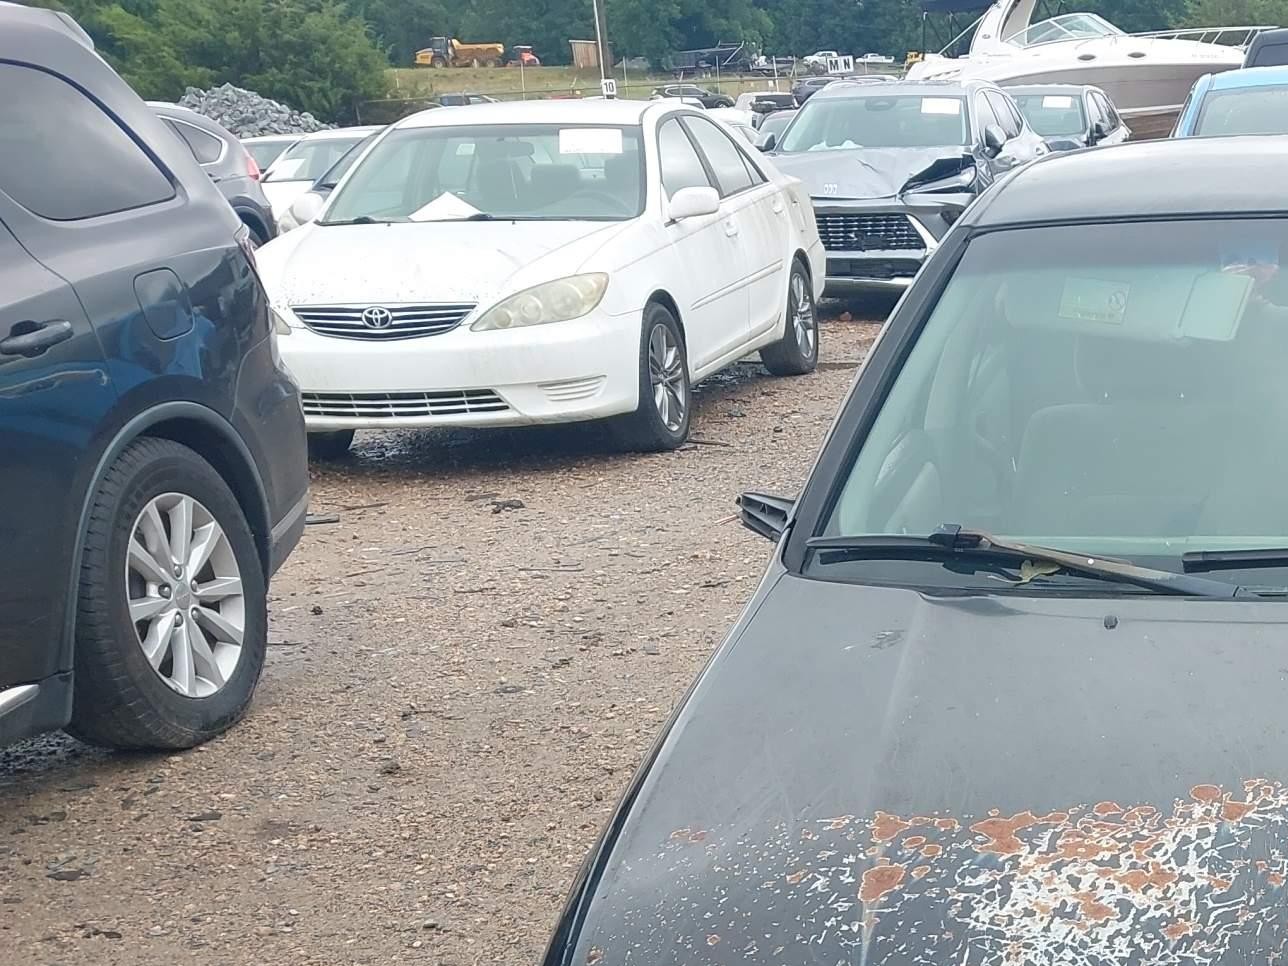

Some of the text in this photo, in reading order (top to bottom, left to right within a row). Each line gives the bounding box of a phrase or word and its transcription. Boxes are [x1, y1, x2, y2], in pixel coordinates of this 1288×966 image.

[829, 58, 851, 71] M N
[604, 81, 614, 93] 10
